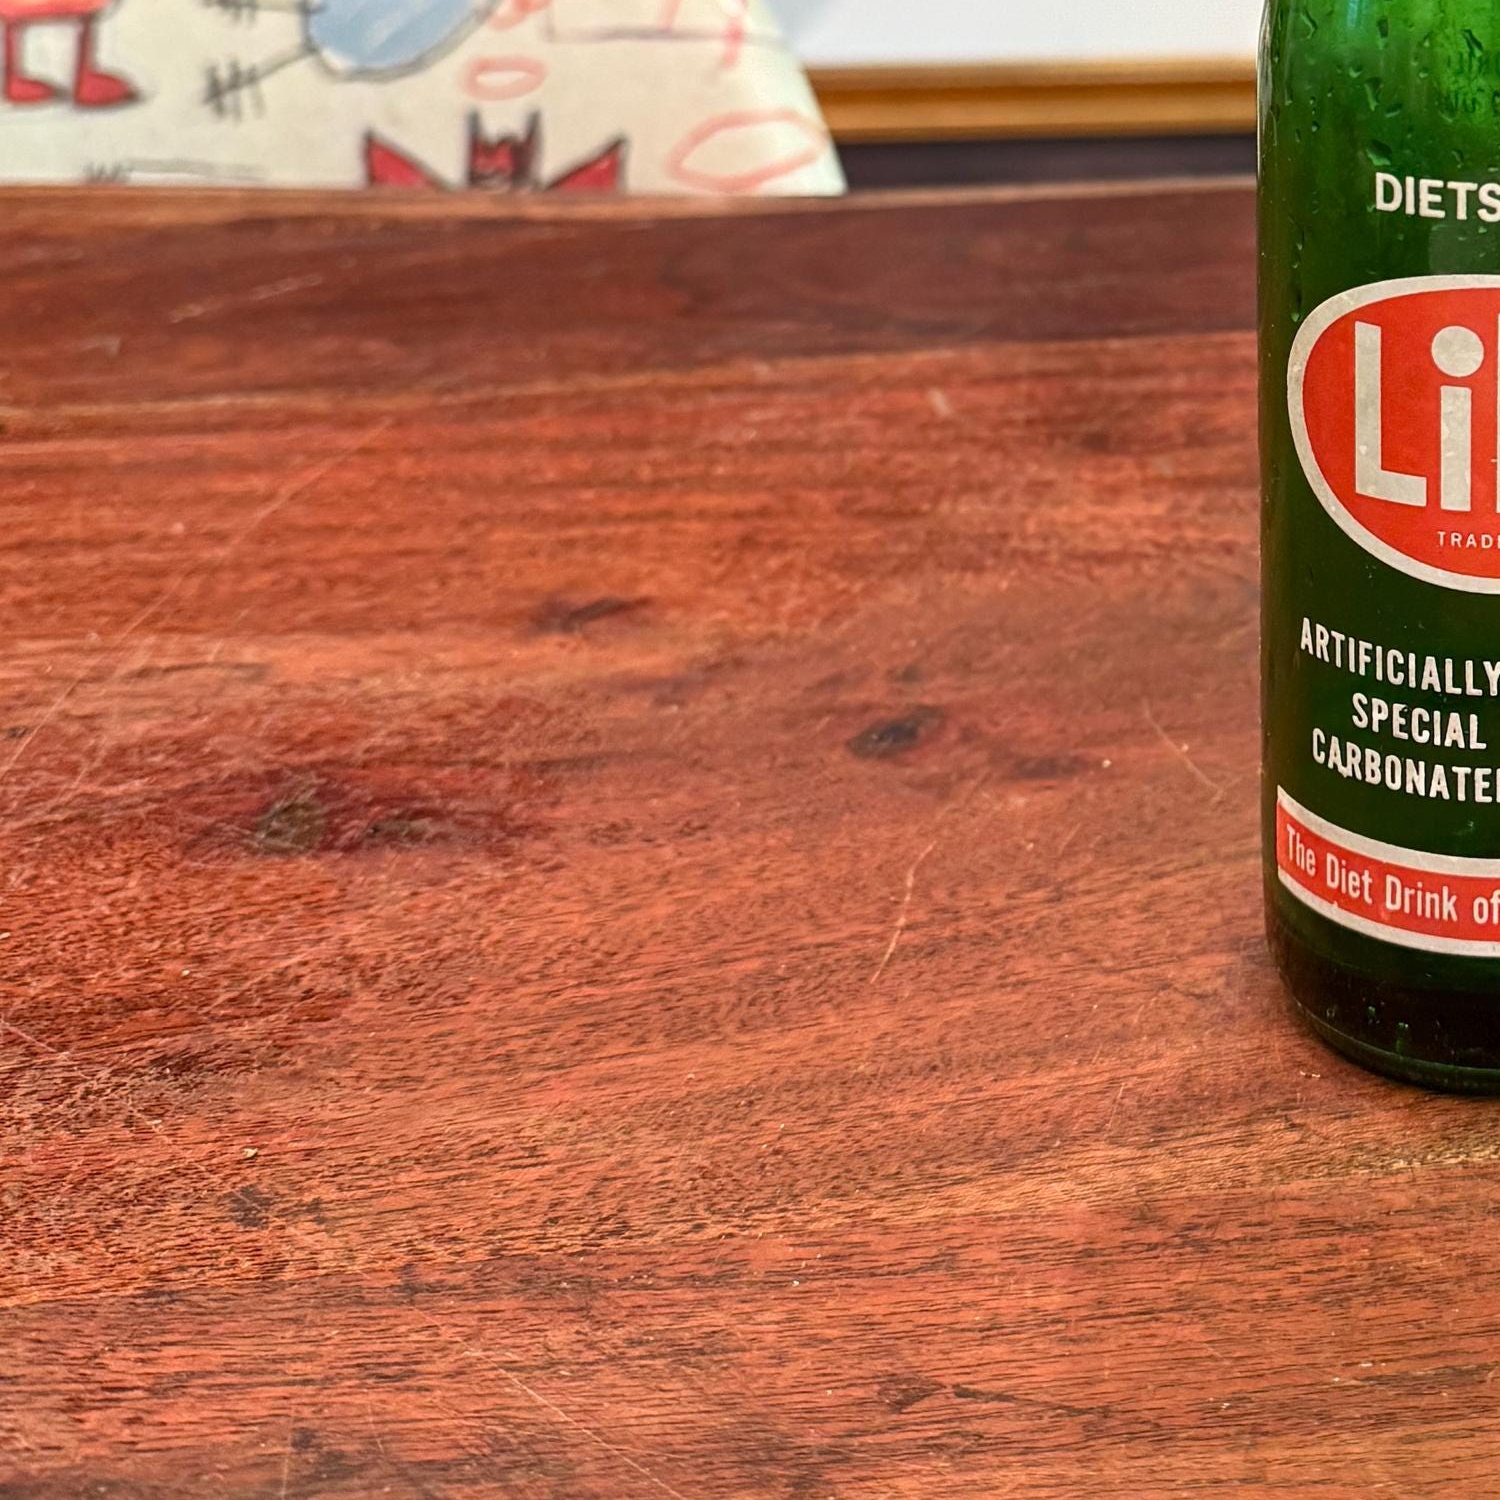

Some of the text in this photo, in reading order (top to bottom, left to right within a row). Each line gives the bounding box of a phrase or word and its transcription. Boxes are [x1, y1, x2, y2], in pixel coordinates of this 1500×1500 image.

[1351, 693, 1487, 750] SPECIAL
[1287, 825, 1317, 878] The
[1325, 852, 1373, 902] Diet
[1385, 875, 1458, 922] Drink
